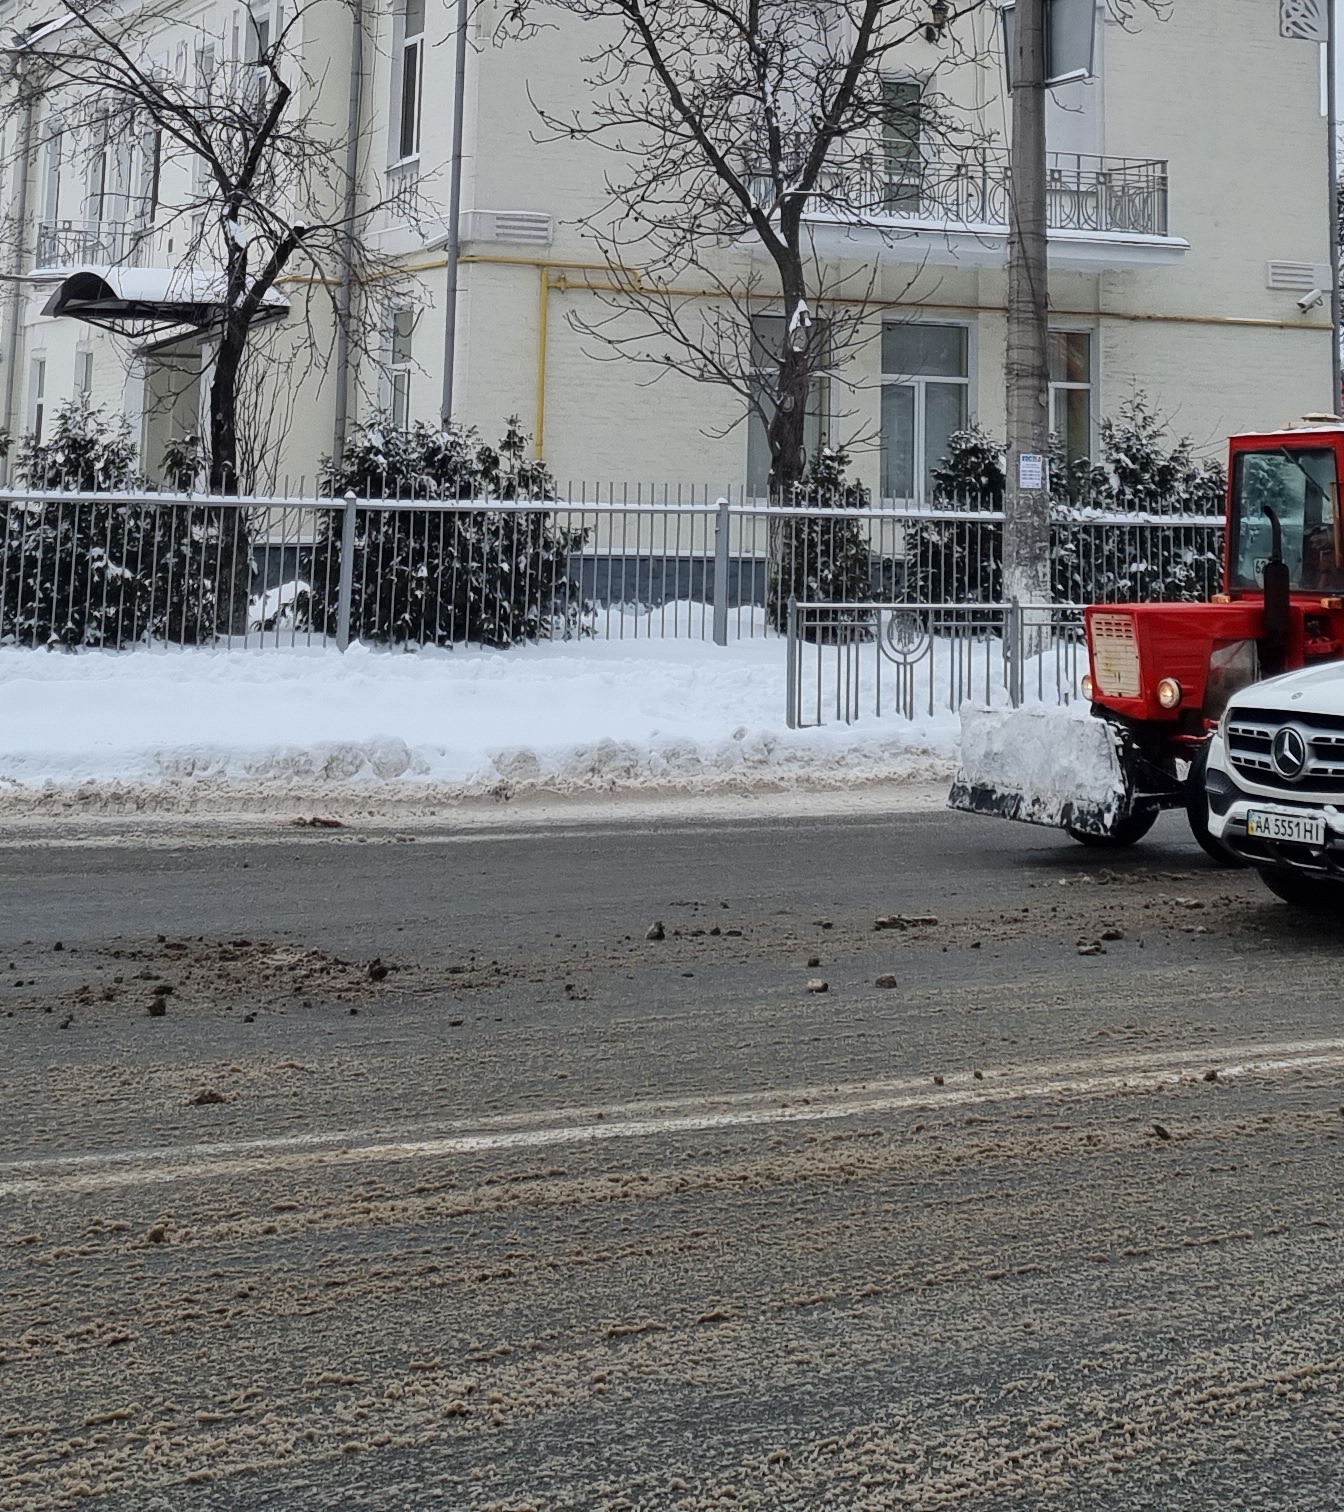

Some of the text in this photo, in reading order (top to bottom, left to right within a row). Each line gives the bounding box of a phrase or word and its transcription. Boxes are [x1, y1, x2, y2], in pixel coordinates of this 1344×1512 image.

[1255, 816, 1320, 842] AA 5551 HI
